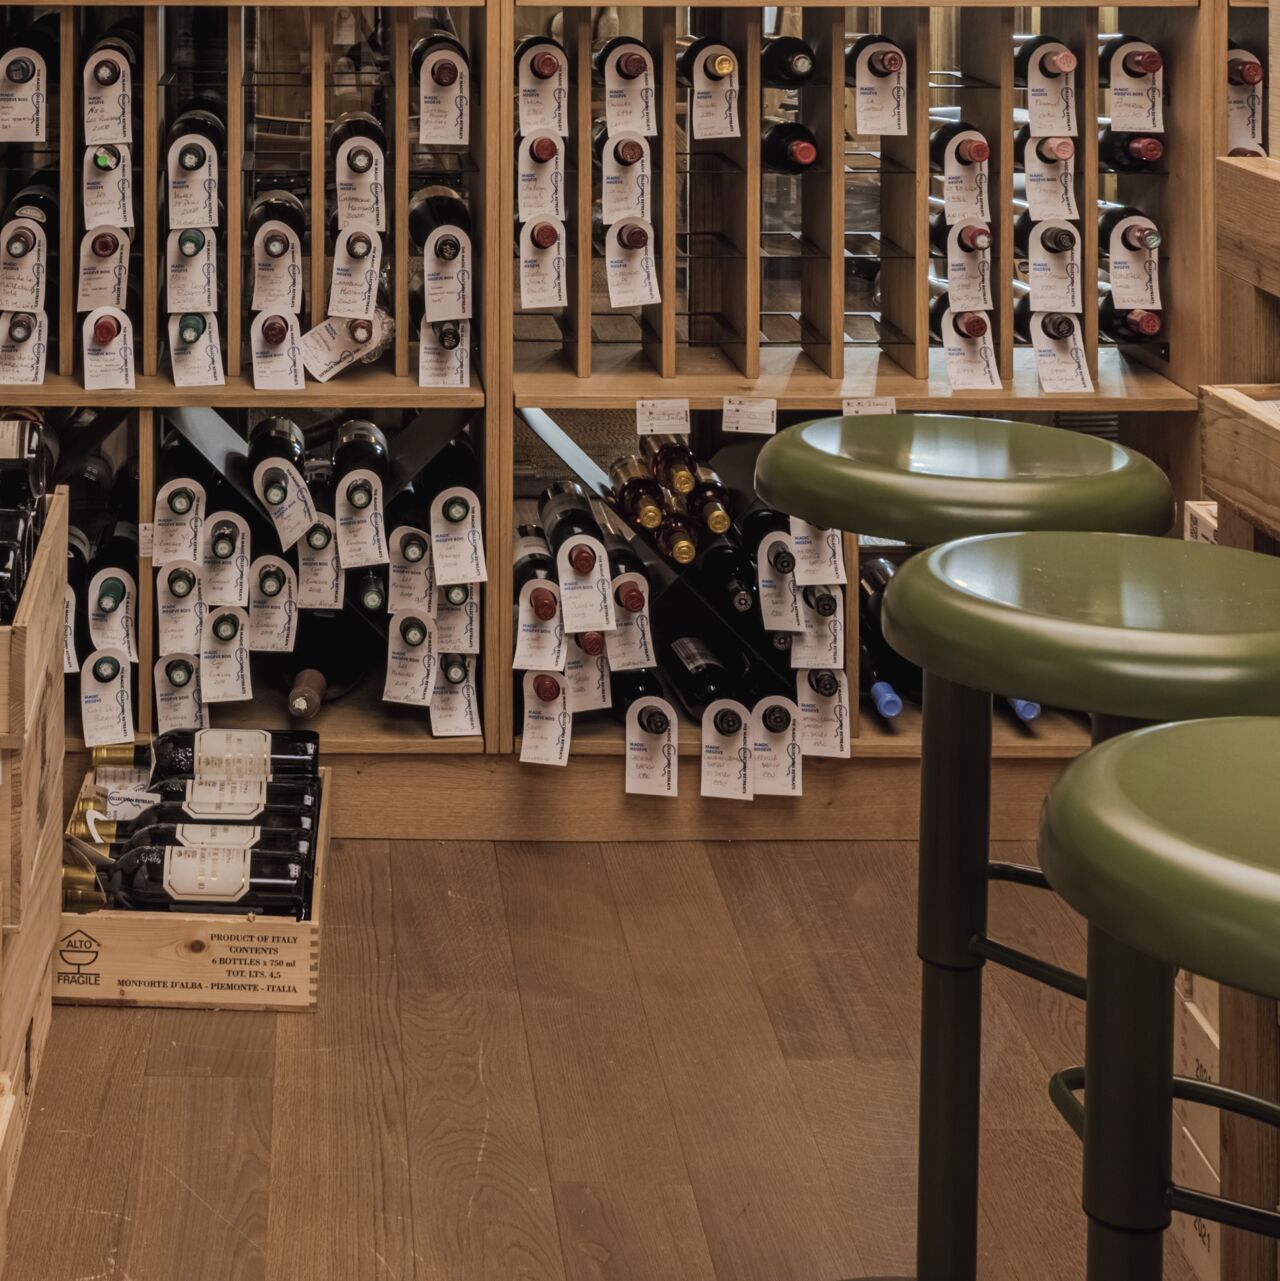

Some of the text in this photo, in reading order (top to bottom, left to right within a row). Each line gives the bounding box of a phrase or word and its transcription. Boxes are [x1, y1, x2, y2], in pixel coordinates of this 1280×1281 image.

[210, 933, 298, 944] PRODUCT OF ITALY
[66, 939, 92, 950] ALTO
[229, 946, 279, 955] CONTENTS
[219, 957, 261, 966] BOTTLES
[269, 959, 284, 967] 750
[285, 960, 296, 968] ml
[57, 975, 101, 986] FRAGILE
[117, 979, 297, 993] MONFORTE D'ALBA PIEMONTE ITALIA
